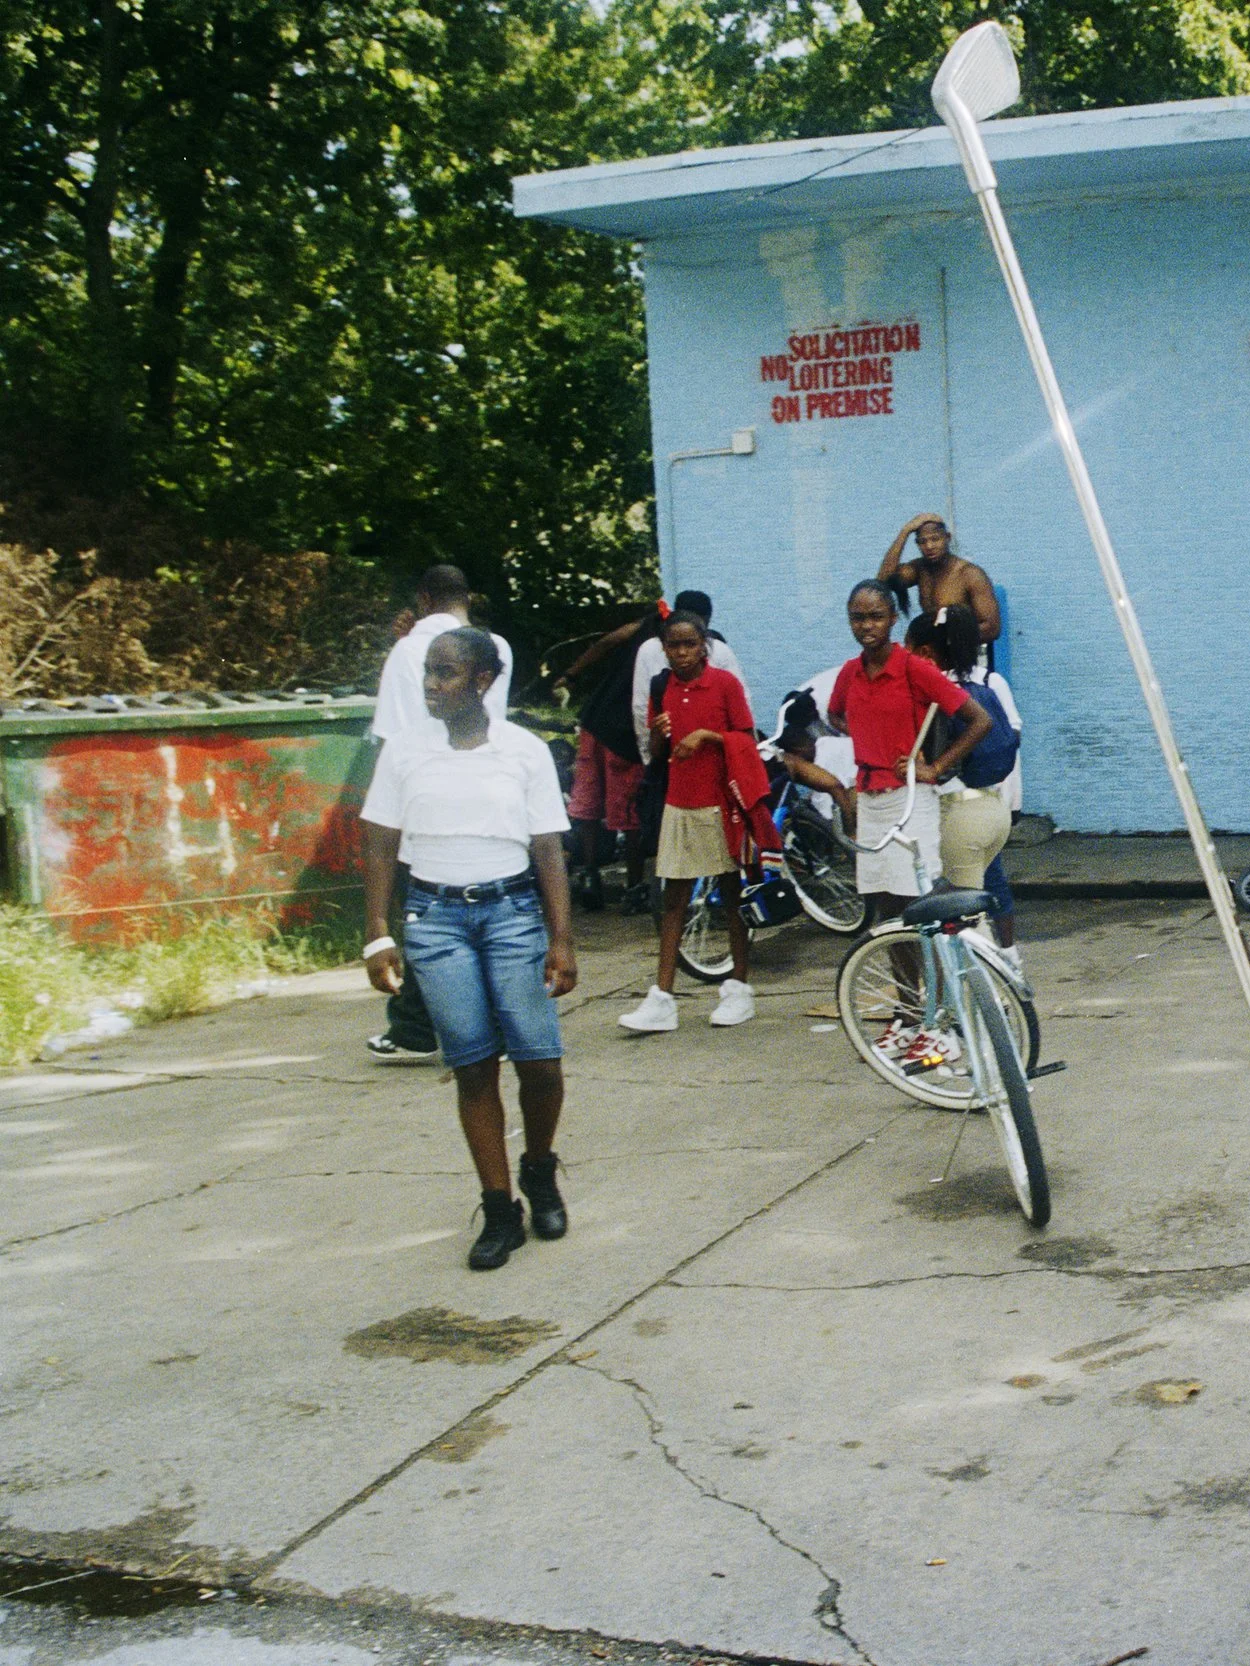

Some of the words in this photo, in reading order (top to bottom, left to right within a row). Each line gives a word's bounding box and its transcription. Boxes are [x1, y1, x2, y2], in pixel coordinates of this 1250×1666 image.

[787, 322, 921, 362] SOLICITATION
[761, 355, 788, 382] NO
[788, 357, 893, 391] LOITERING
[771, 396, 800, 424] ON
[806, 387, 894, 420] PREMISE
